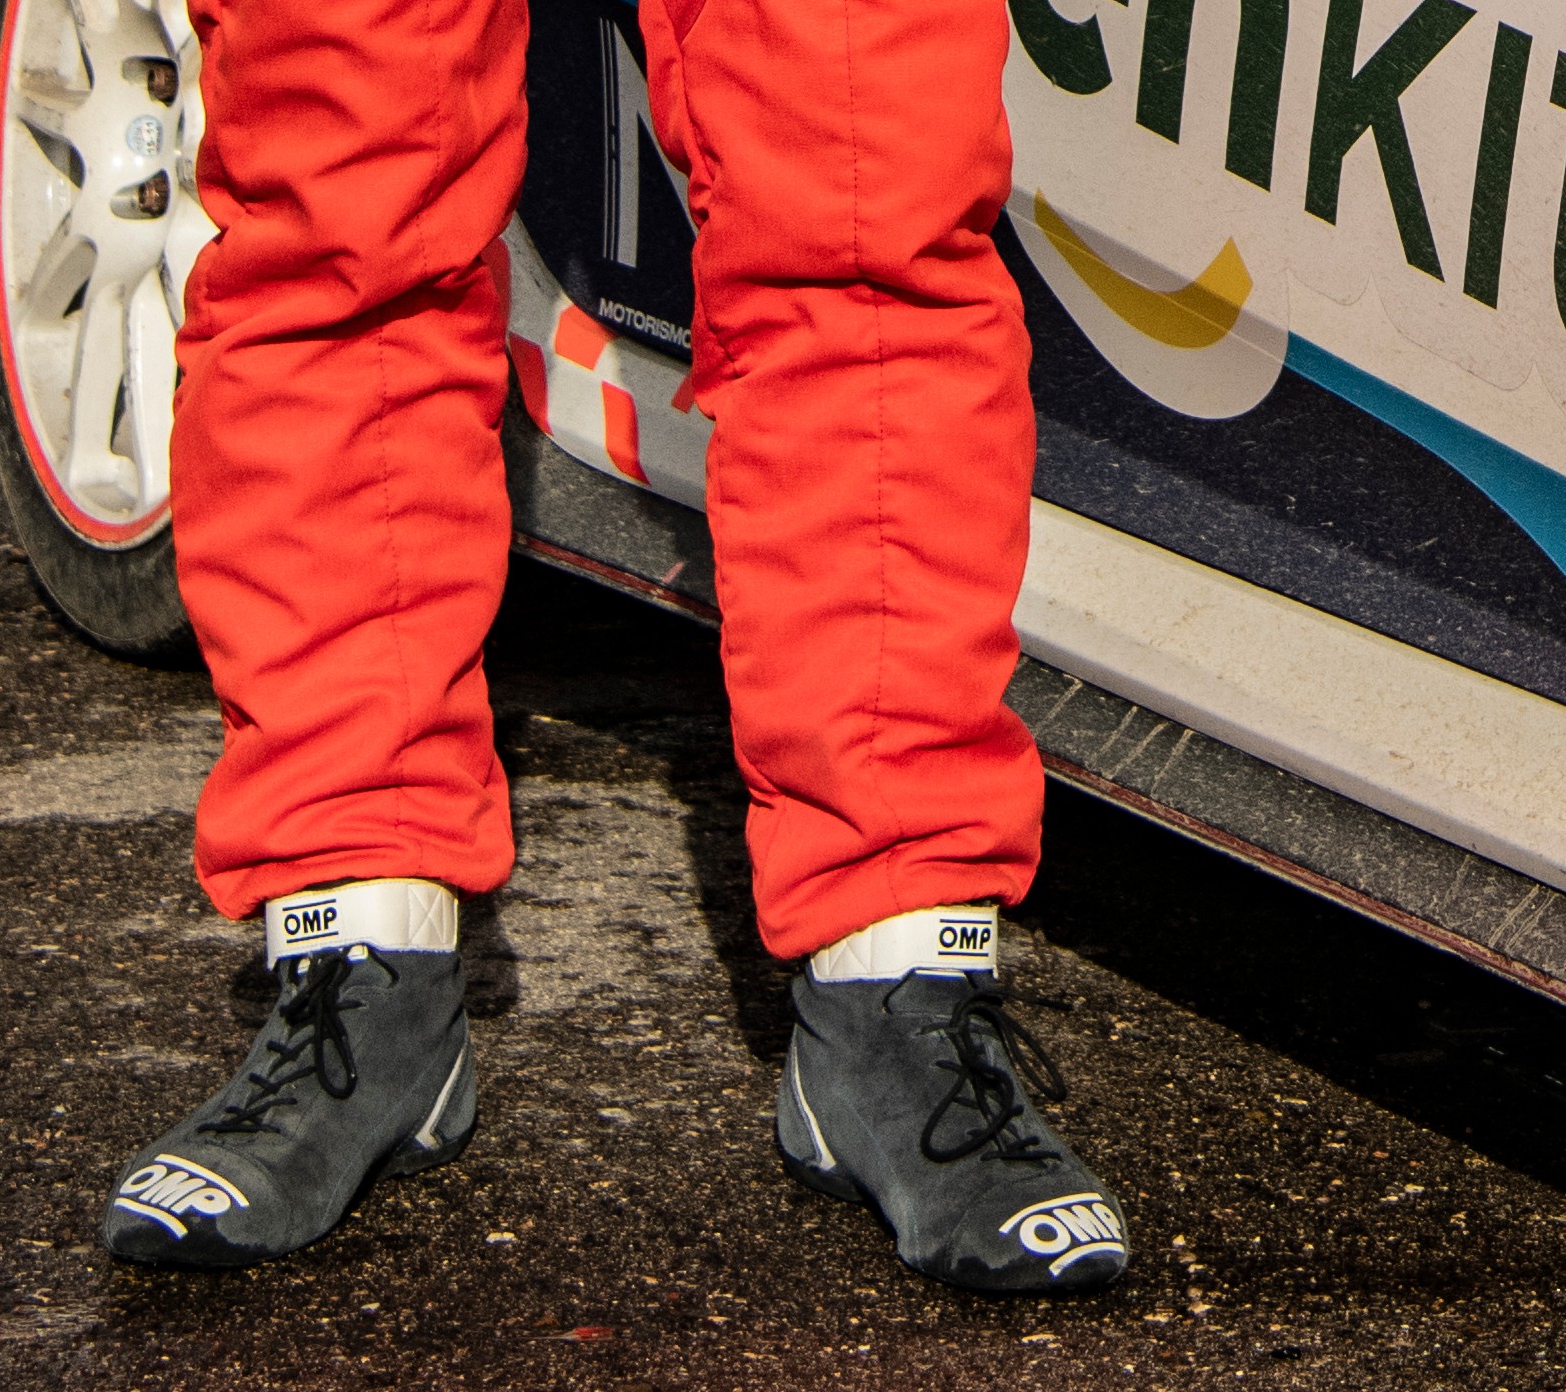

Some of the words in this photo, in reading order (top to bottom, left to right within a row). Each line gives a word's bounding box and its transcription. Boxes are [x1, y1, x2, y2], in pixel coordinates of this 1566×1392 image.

[284, 907, 338, 936] OMP
[939, 925, 991, 951] OMP
[120, 1162, 232, 1216] OMP
[1019, 1200, 1121, 1255] OMP
